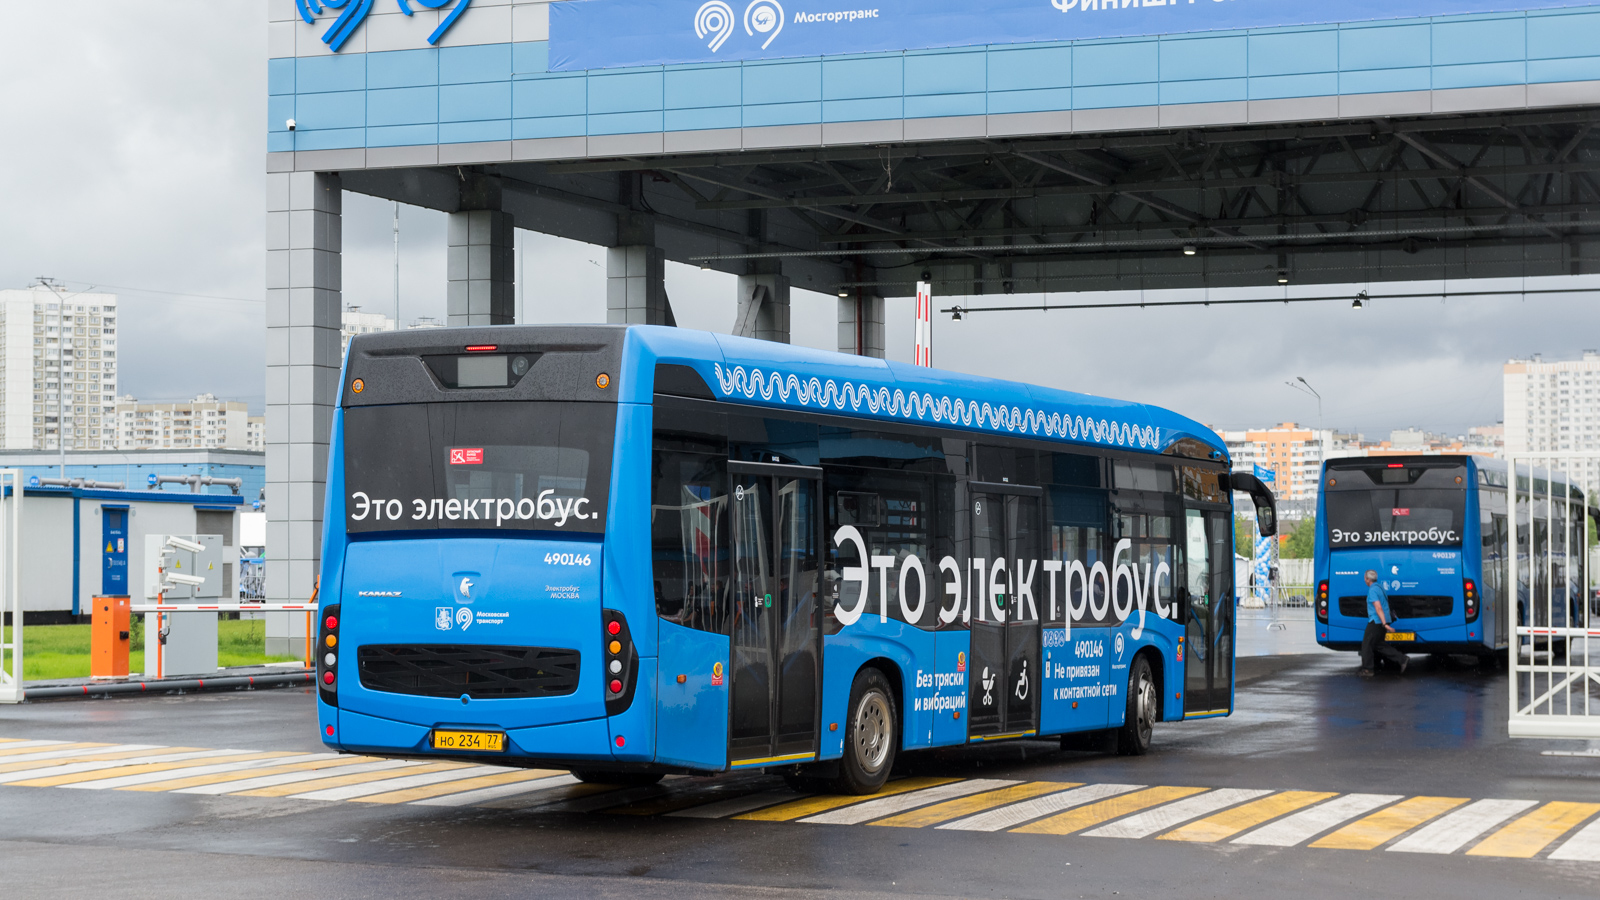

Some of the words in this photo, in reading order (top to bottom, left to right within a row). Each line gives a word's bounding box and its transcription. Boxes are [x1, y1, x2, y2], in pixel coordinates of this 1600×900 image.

[794, 9, 879, 23] Мосгортранс
[351, 491, 403, 520] Это
[411, 489, 598, 527] электробус.
[1332, 529, 1360, 542] Это
[1364, 527, 1460, 544] электробус.
[543, 552, 592, 566] 490146
[833, 525, 926, 626] Это
[939, 538, 1178, 641] электробус.
[1074, 640, 1104, 658] 490146
[916, 669, 933, 688] Без
[934, 672, 964, 691] тряски
[1054, 662, 1065, 679] Не
[1066, 665, 1100, 682] привязан
[1053, 688, 1059, 700] к
[1060, 681, 1101, 700] контактной
[1101, 684, 1117, 697] сети
[914, 698, 922, 711] и
[923, 691, 966, 714] вибраций
[459, 734, 480, 747] 234
[487, 734, 498, 744] 77
